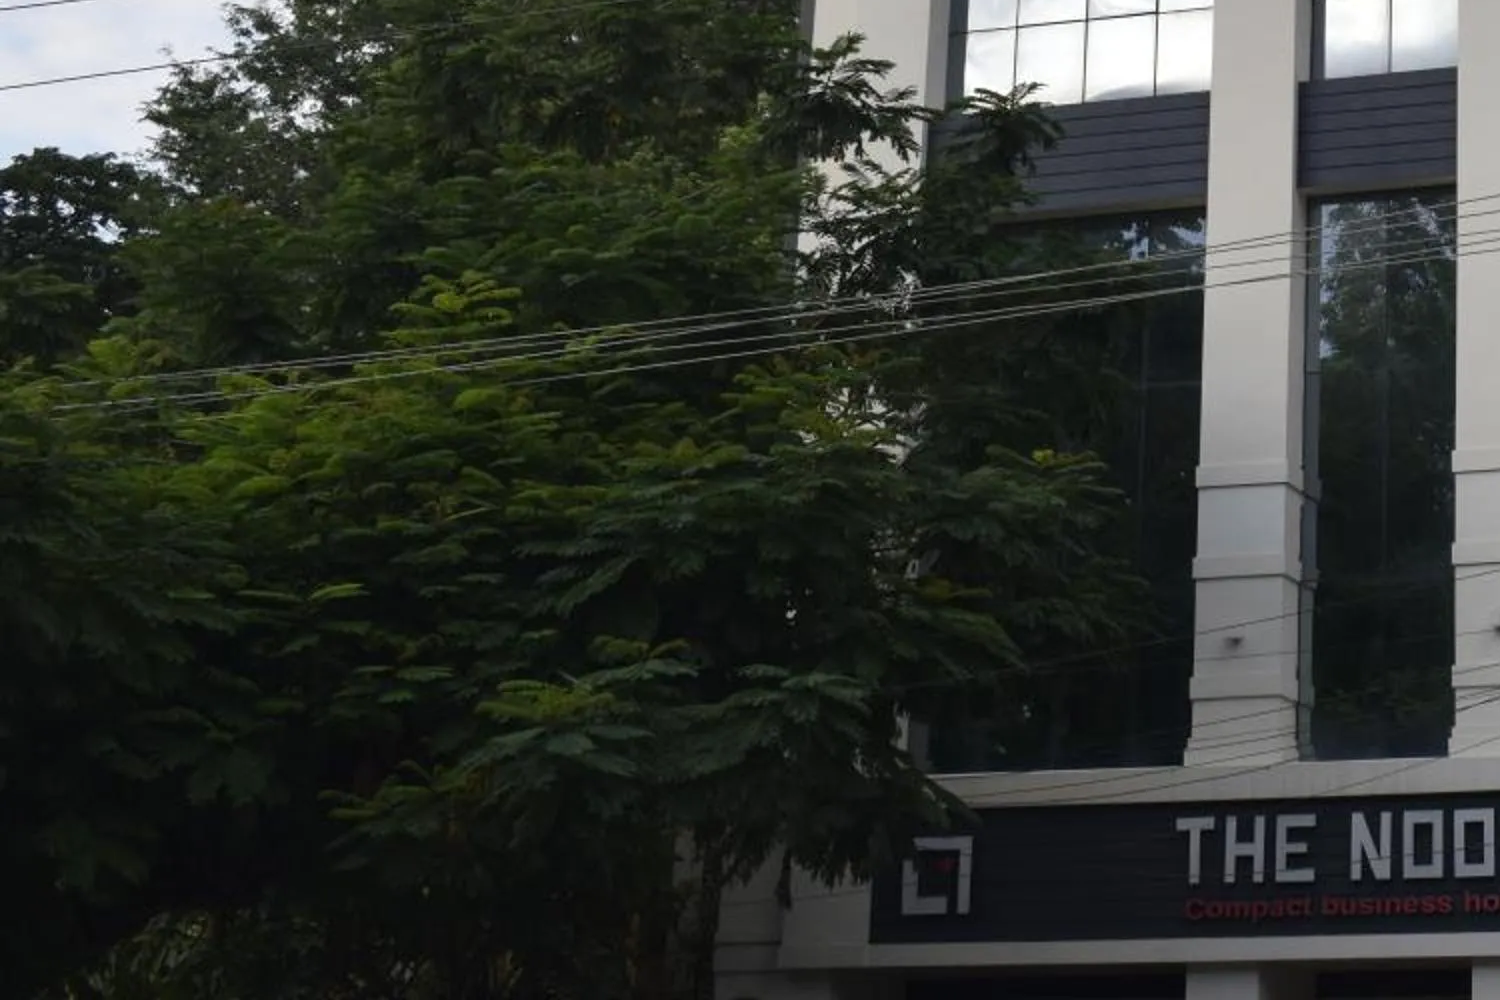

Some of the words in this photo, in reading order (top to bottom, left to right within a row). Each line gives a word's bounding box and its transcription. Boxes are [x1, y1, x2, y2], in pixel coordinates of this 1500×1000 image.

[1175, 814, 1317, 885] THE
[1184, 897, 1312, 922] Compact
[1322, 892, 1454, 917] business
